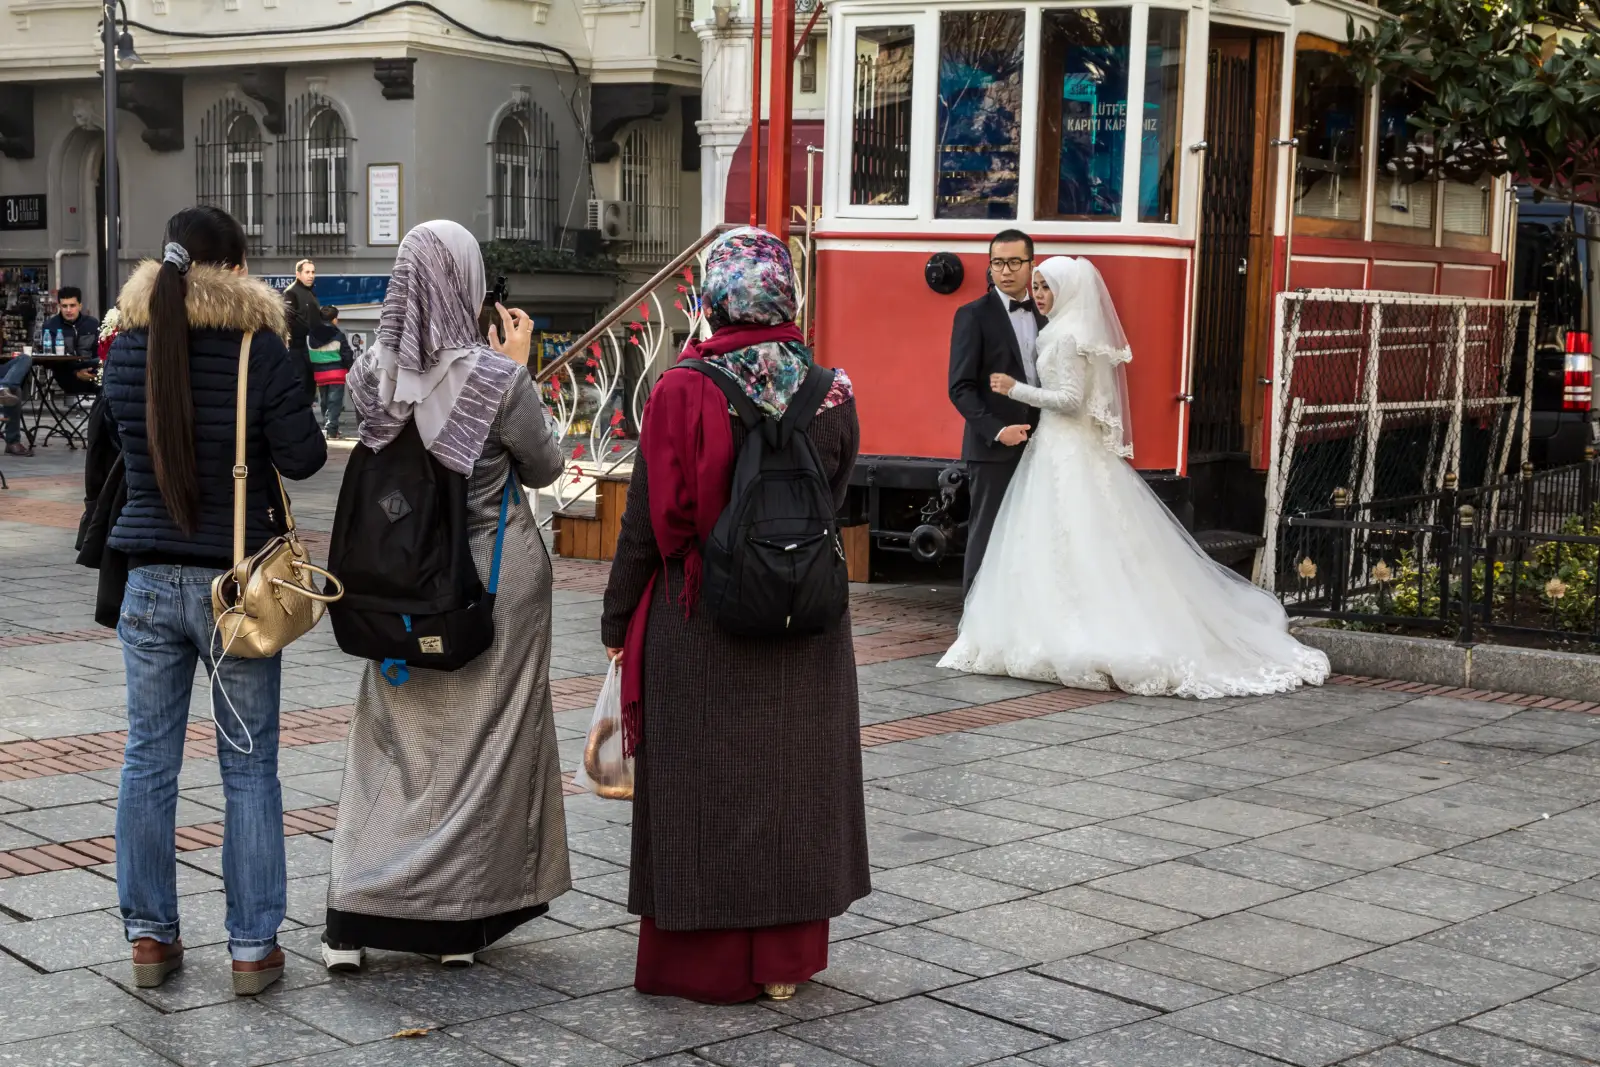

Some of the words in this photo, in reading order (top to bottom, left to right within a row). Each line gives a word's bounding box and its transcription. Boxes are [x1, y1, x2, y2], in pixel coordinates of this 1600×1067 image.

[1091, 102, 1126, 116] LÜTFE
[1067, 118, 1101, 131] KAPIYI
[1105, 118, 1157, 131] KAPNIZ
